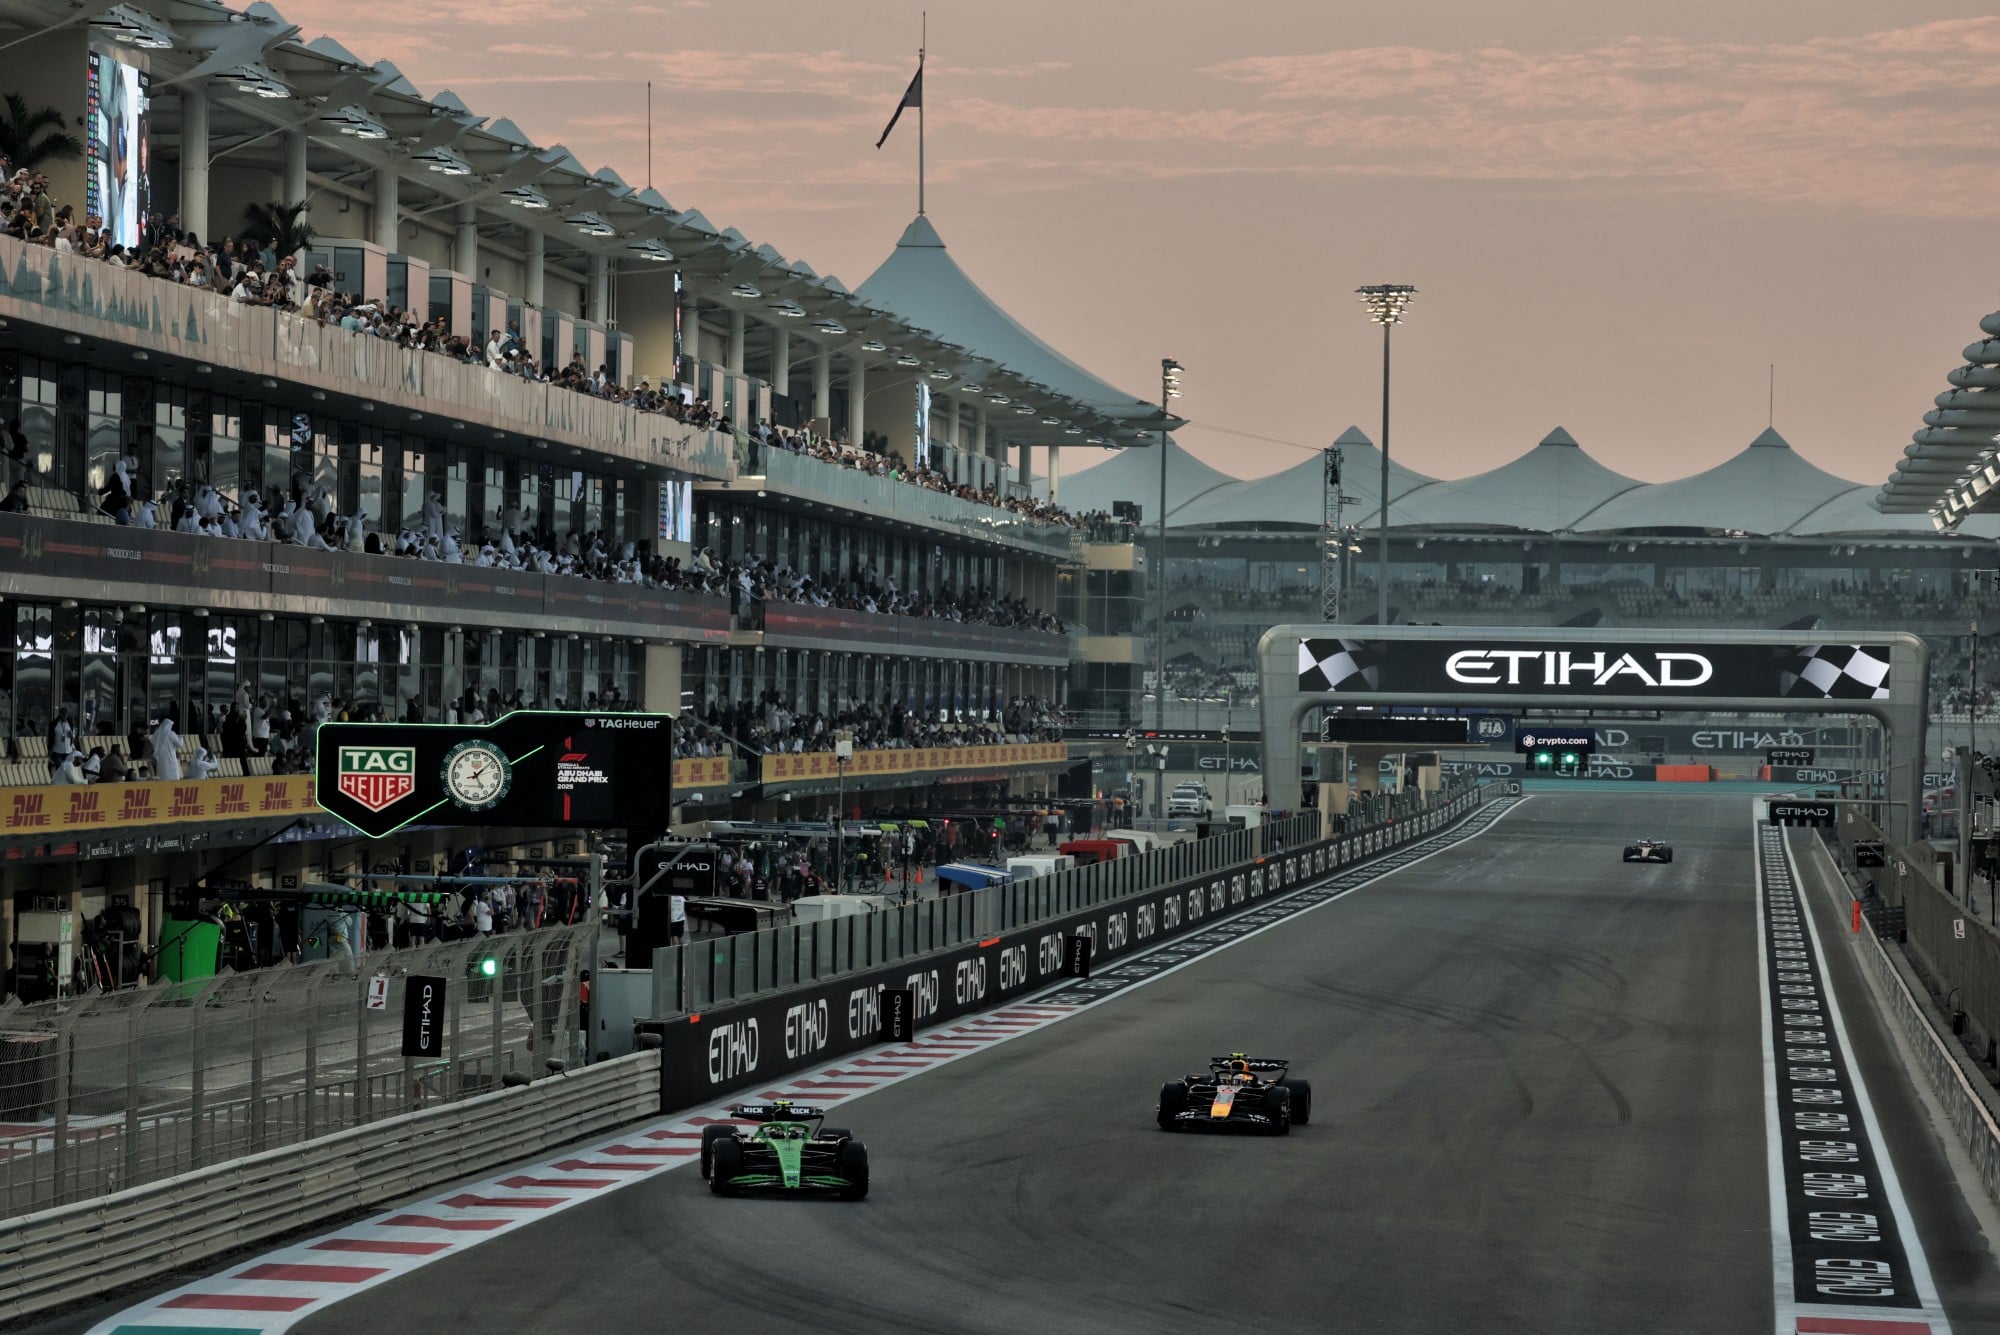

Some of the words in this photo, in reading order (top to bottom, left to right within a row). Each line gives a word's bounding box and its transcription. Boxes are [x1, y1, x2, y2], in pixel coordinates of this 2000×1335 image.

[1446, 650, 1713, 687] ETIHAD
[1537, 737, 1588, 747] crypto.com
[1691, 730, 1805, 750] ETIHAD
[1771, 750, 1811, 758] ETIHAD
[345, 751, 408, 771] TAG
[1199, 756, 1262, 769] ETHA
[1797, 770, 1838, 783] ETIHAD
[342, 776, 412, 808] HEUER
[1922, 773, 1957, 786] ETIHA
[1775, 807, 1830, 817] ETIHAD
[284, 877, 295, 886] 32
[115, 897, 127, 906] 35
[1107, 911, 1128, 950] ETIHAD
[1136, 902, 1156, 940] ETIHAD
[999, 944, 1027, 990] ETIHAD
[1039, 931, 1063, 976] ETIHAD
[956, 956, 987, 1005] ETIHAD
[419, 984, 433, 1050] ETIHAD
[785, 998, 828, 1059] ETIHAD
[893, 994, 902, 1038] ETIHAD
[709, 1017, 759, 1084] ETIHAD
